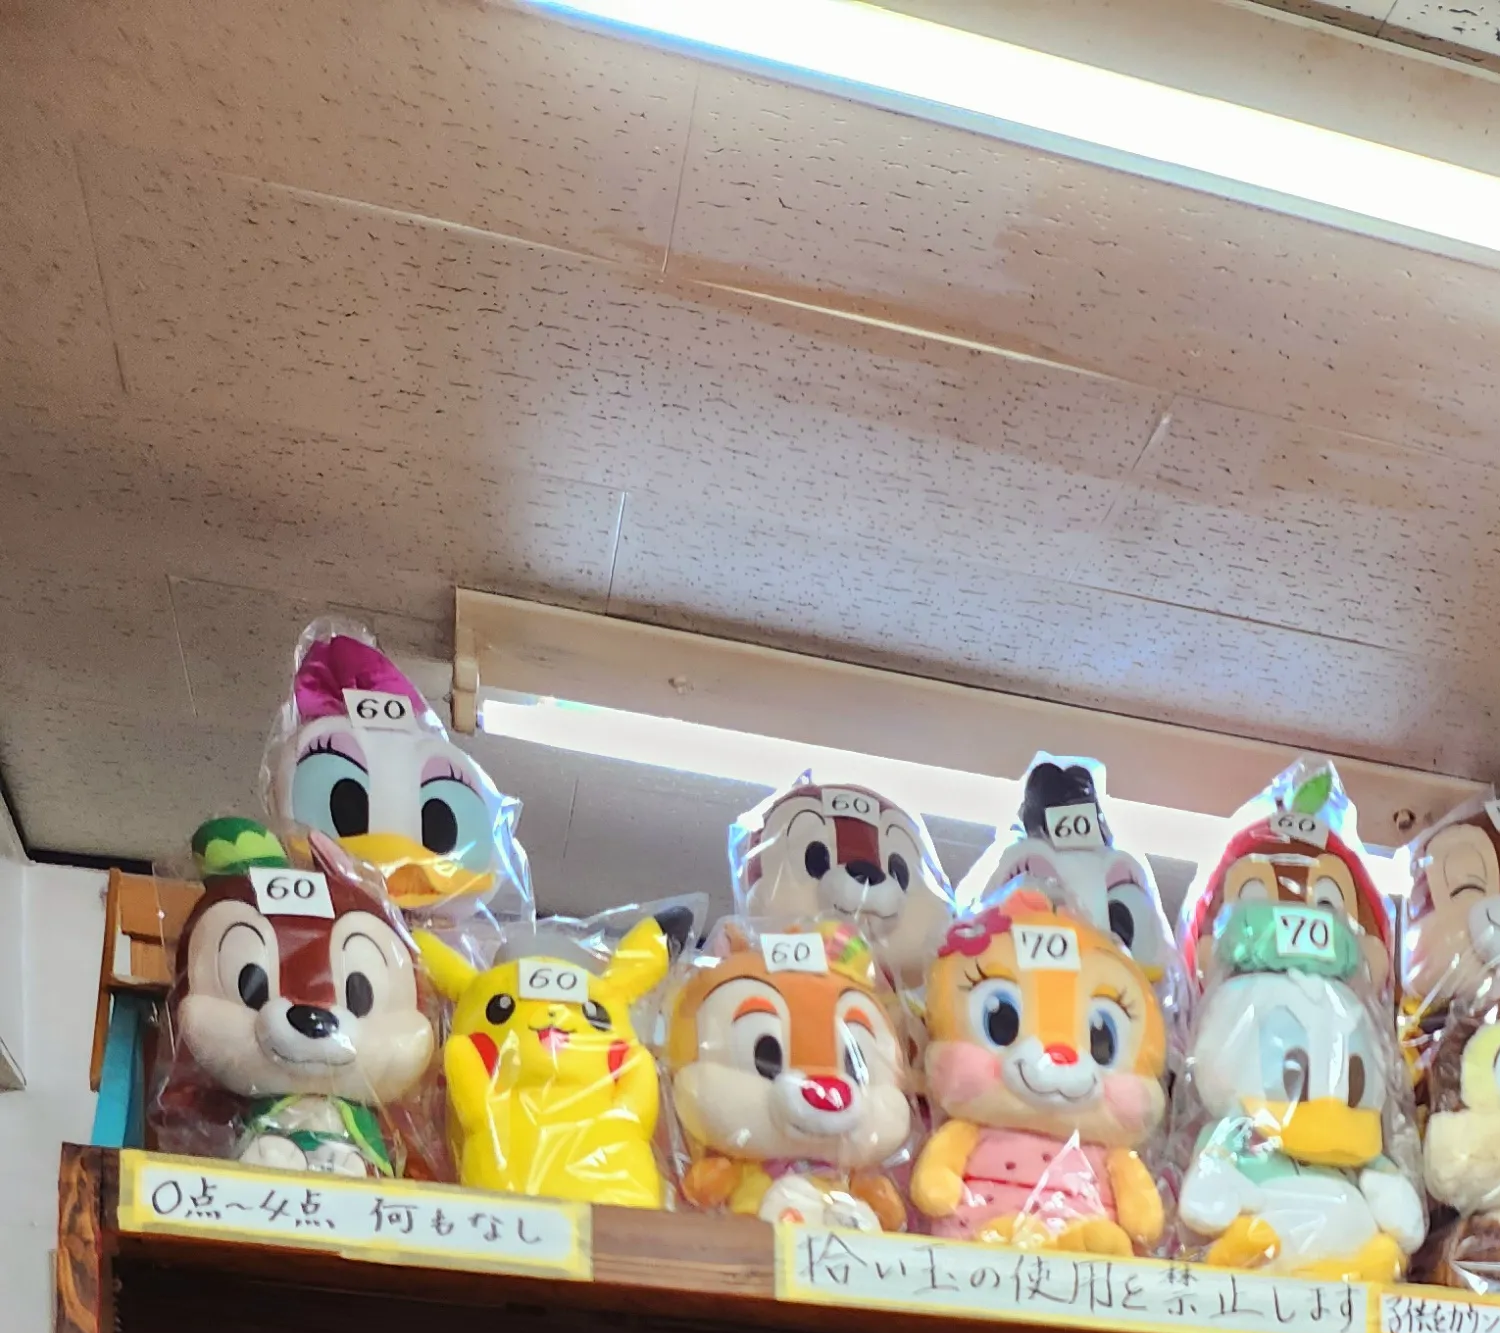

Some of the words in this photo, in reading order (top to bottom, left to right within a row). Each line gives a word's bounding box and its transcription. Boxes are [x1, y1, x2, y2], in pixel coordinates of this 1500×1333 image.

[355, 699, 406, 720] 60
[831, 794, 873, 815] 60
[1054, 816, 1091, 838] 60
[1277, 815, 1317, 834] 60
[265, 876, 315, 900] 60
[1280, 914, 1330, 947] 70
[770, 940, 812, 962] 60
[1019, 930, 1068, 958] 70
[527, 967, 578, 992] 60
[369, 1197, 545, 1245] 何もなし
